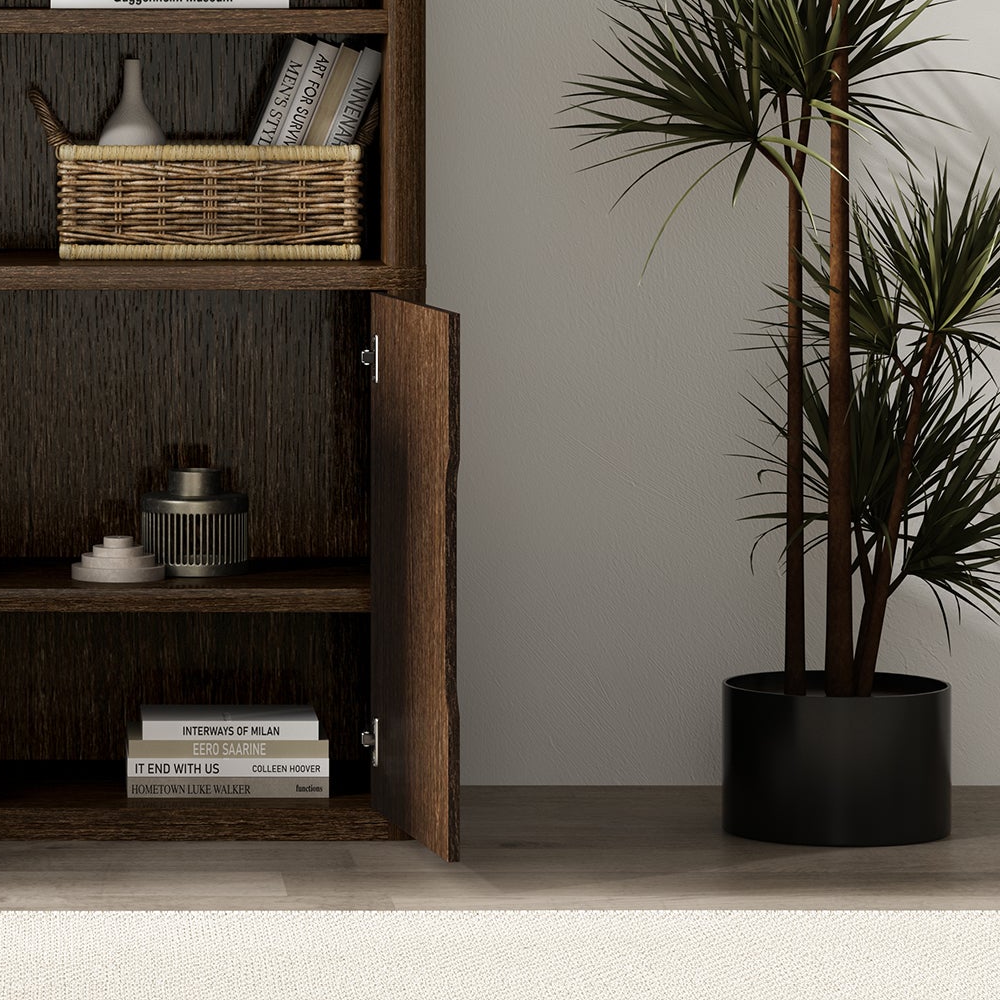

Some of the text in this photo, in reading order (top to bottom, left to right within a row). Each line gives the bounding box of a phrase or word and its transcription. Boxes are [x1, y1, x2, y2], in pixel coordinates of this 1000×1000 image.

[312, 53, 329, 78] ART
[274, 60, 302, 108] MEN'S
[300, 80, 320, 105] FOR
[182, 726, 280, 736] INTERWAYS OF MILAN
[192, 742, 266, 755] EERO SAARINE
[135, 763, 220, 774] IT END WITH US
[252, 764, 321, 773] COLLEEN HOOVER
[131, 784, 251, 795] HOMETOWN LUKE WALKER
[295, 784, 323, 793] functions
